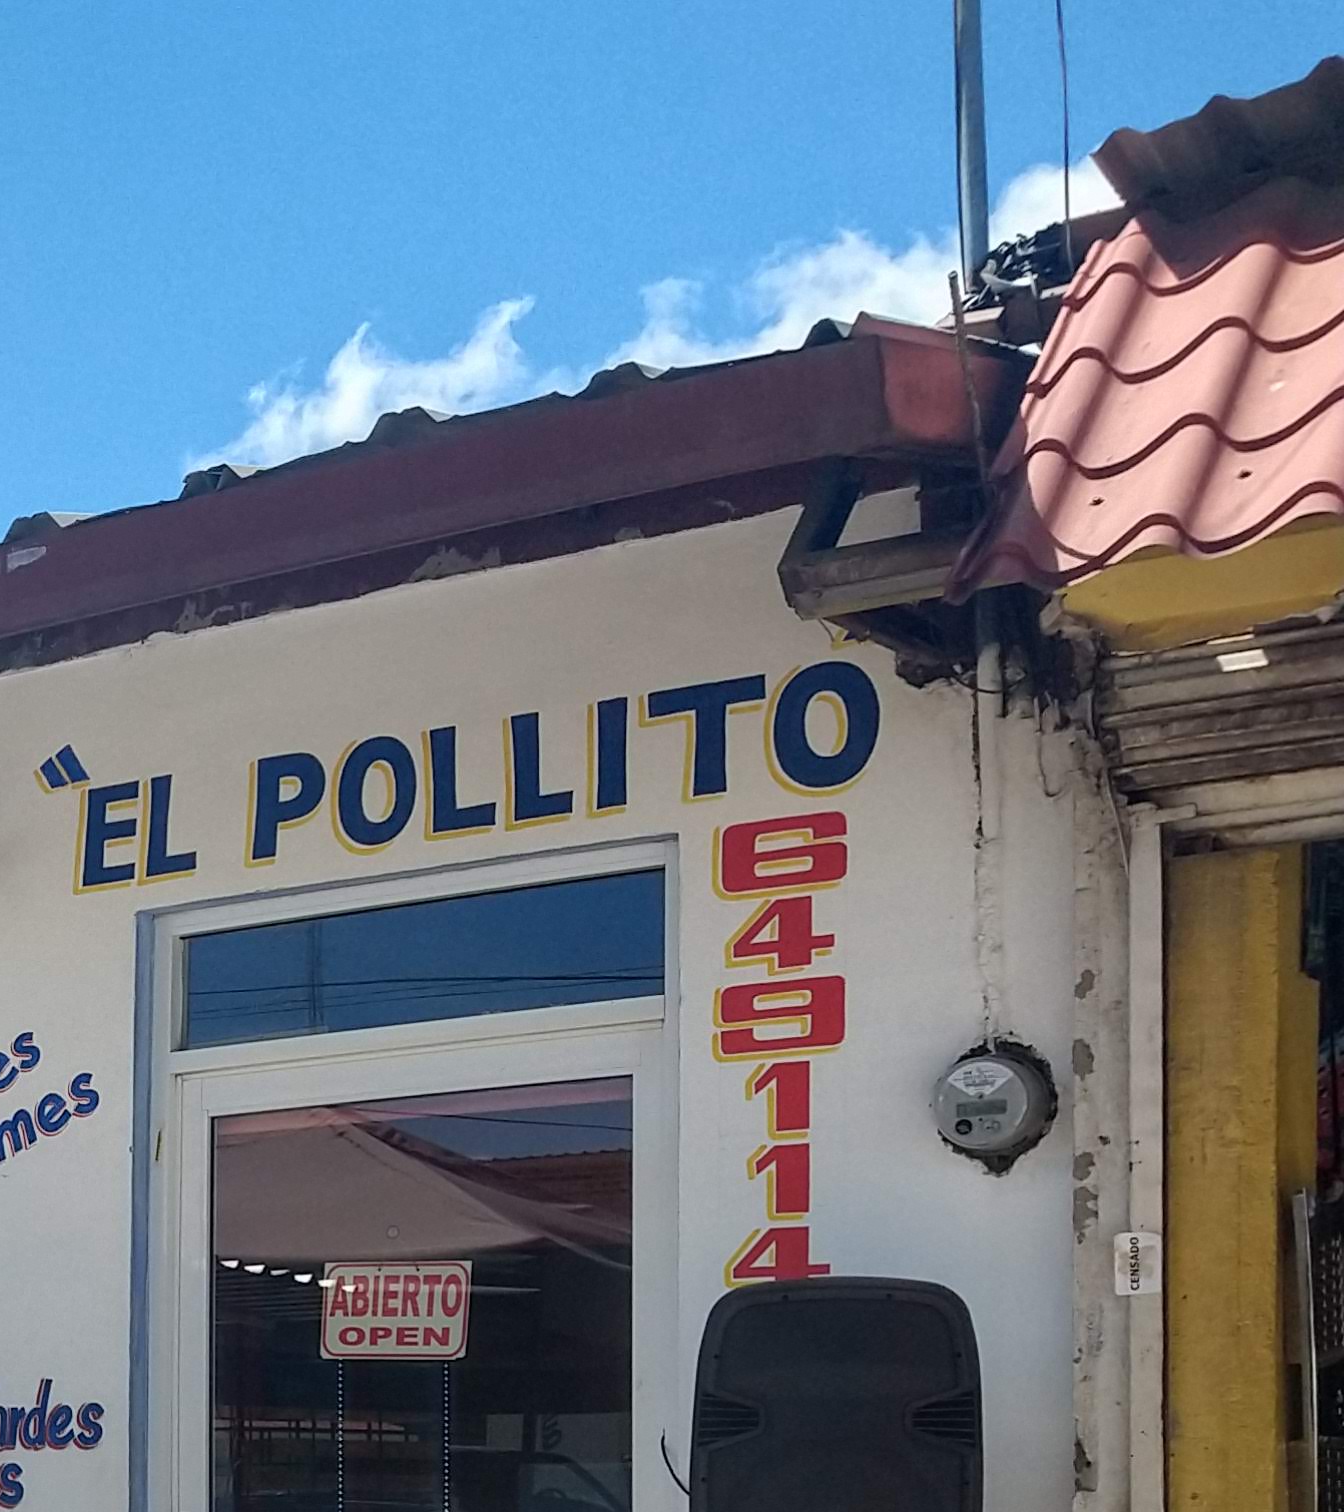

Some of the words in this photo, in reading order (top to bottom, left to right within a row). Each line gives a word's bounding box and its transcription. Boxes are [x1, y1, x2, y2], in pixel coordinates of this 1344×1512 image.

[244, 660, 882, 868] POLLITO
[1129, 1236, 1141, 1291] CENSADO
[329, 1273, 463, 1318] ABIERTO
[338, 1327, 450, 1346] OPEN
